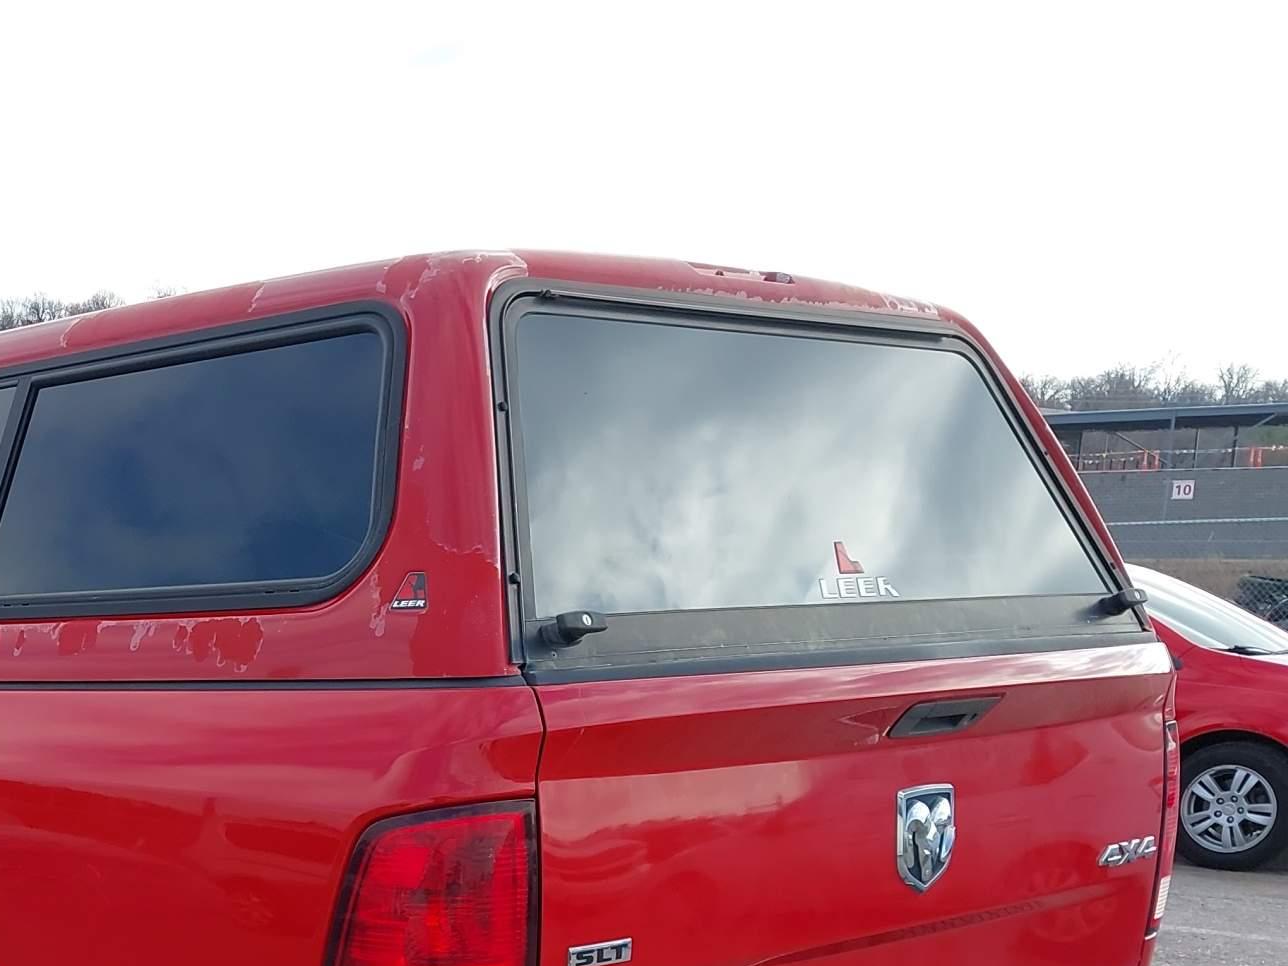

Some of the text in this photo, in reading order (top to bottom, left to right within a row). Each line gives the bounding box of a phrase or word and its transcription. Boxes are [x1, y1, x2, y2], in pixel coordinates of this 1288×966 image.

[1175, 484, 1192, 496] 10
[818, 576, 900, 599] LEER
[392, 599, 426, 608] LEER
[572, 943, 629, 966] SLT
